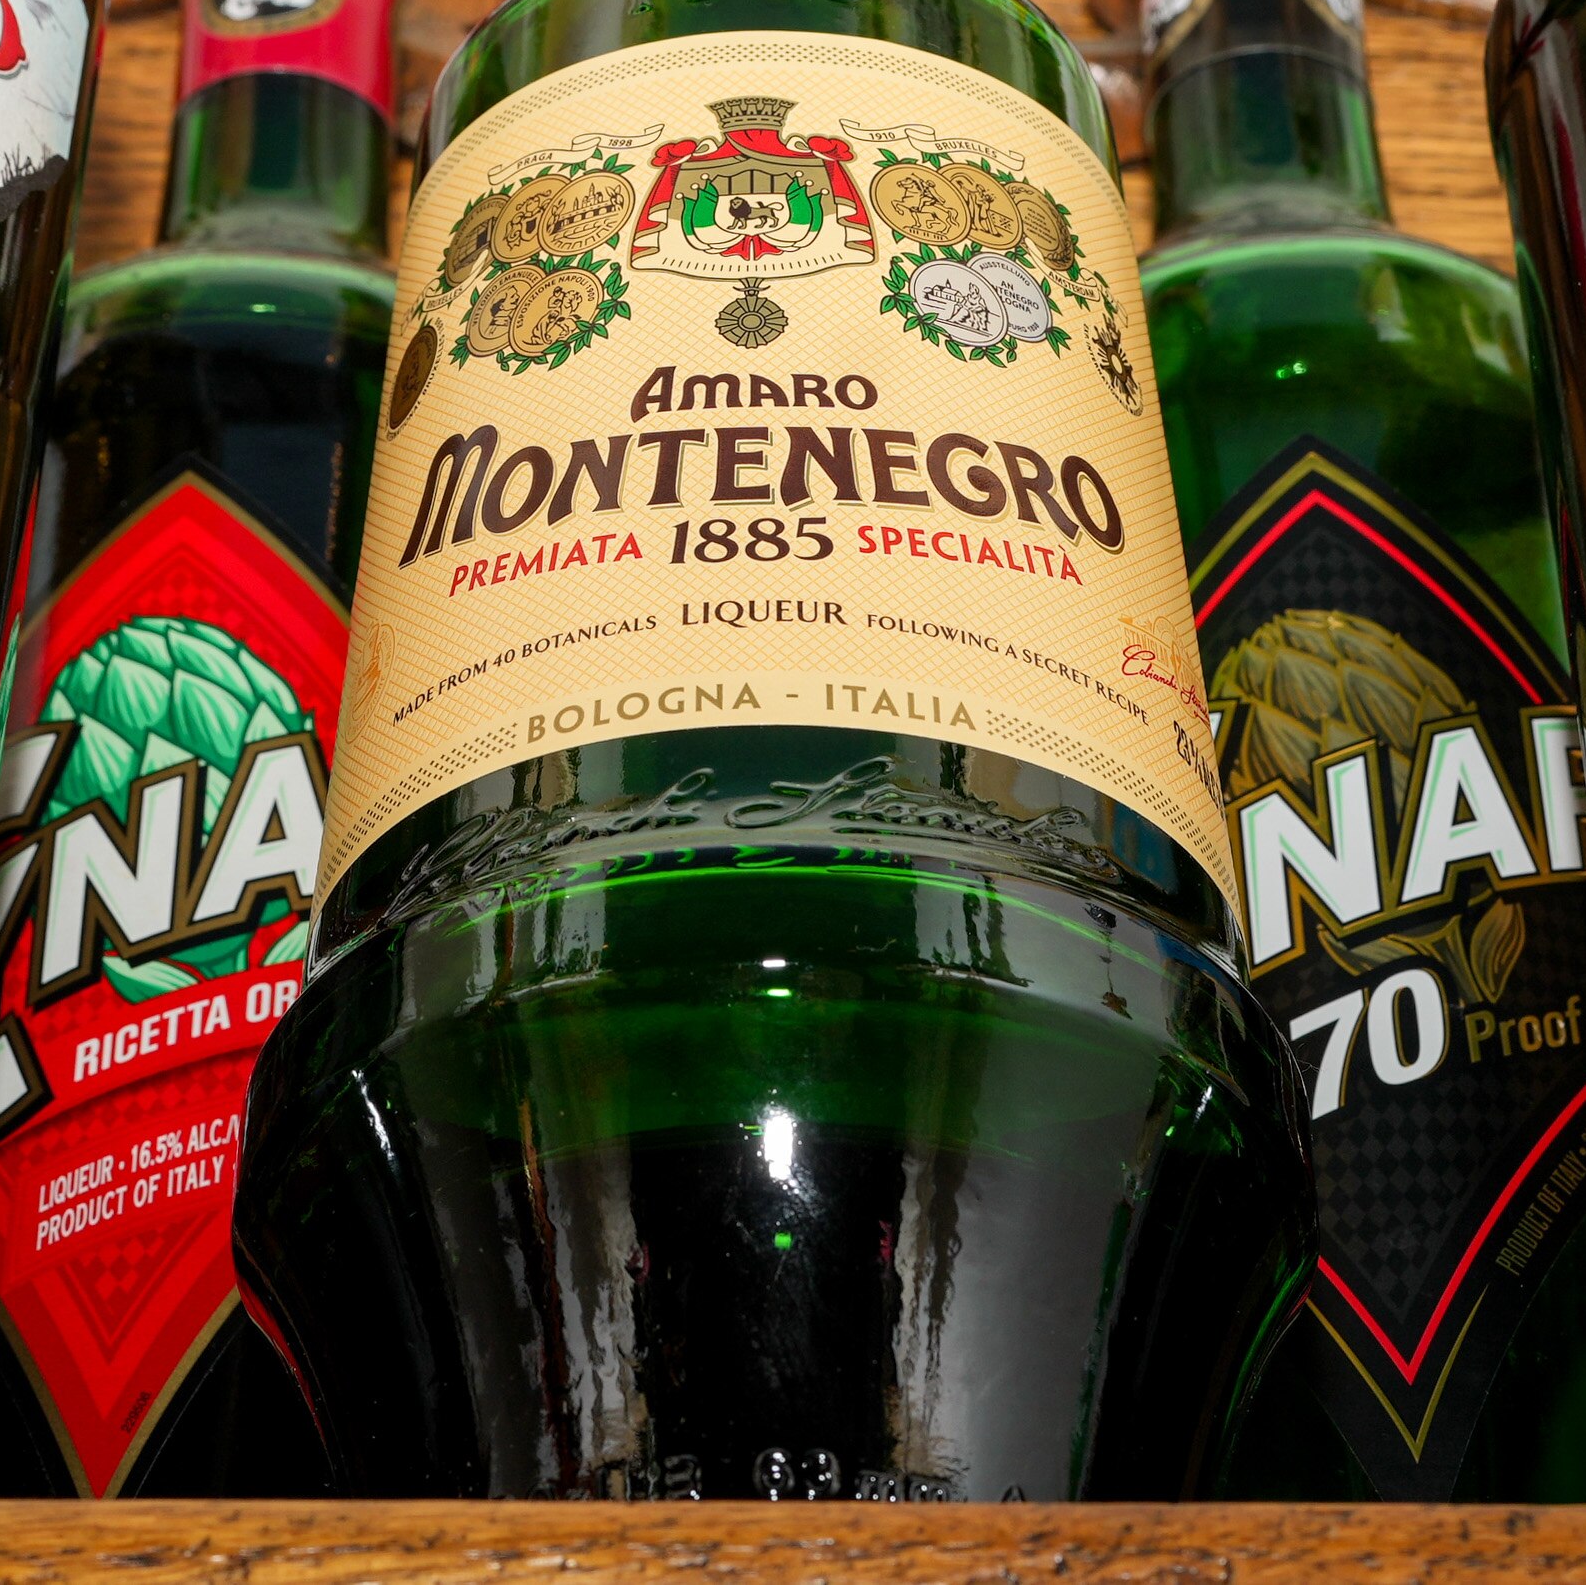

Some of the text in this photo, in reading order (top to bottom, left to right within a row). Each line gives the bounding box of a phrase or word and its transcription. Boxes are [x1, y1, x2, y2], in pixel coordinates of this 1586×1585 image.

[516, 137, 634, 170] PRAGA 1898
[868, 130, 999, 160] 1910 BRUXELLES
[498, 270, 539, 286] EMANUELE
[515, 275, 596, 329] ESPOSIZIONE NAPOLI 1900
[979, 260, 1031, 288] AUSSTELLUNG
[1000, 280, 1015, 291] AN
[1047, 270, 1097, 298] AMSTERDAM
[630, 365, 880, 424] AMARO
[397, 424, 1127, 568] MONTENEGRO
[449, 517, 1084, 598] PREMIATA 1885 SPECIALITÀ
[392, 690, 435, 728] MADE
[437, 661, 489, 697] FROM
[492, 647, 517, 669] 40
[520, 614, 658, 659] BOTANICALS
[680, 598, 848, 629] LIQUEUR
[866, 613, 1000, 654] FOLLOWING
[1004, 644, 1018, 659] A
[1021, 648, 1091, 690] SECRET
[1095, 680, 1150, 727] RECIPE
[526, 682, 977, 746] BOLOGNA ITALIA
[73, 994, 231, 1084] RICETTA
[1289, 967, 1583, 1121] 70 Proof
[35, 1154, 225, 1252] PRODUCT OF ITALY
[38, 1129, 184, 1213] LIQUEUR 16.5%
[1495, 1203, 1554, 1277] PRODUCT
[1537, 1182, 1565, 1216] OF
